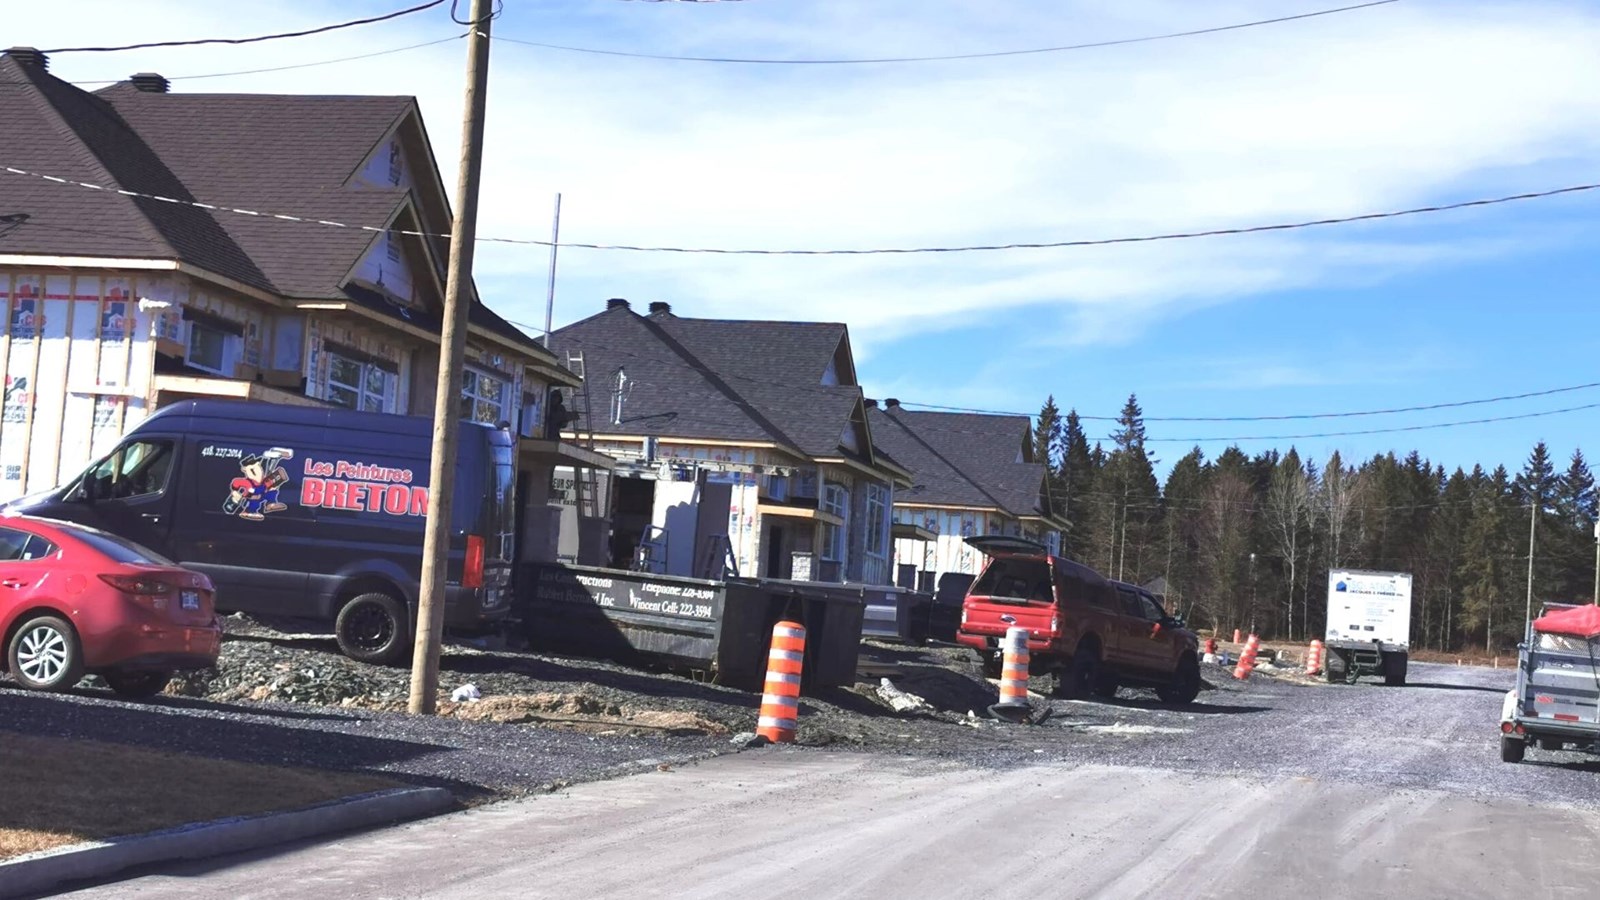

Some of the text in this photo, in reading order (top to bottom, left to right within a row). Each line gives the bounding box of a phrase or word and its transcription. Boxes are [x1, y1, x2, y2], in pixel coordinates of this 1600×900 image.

[304, 458, 412, 483] Les Peintures
[301, 478, 429, 516] BRETON
[633, 597, 712, 618] Vincent Cell: 222-3594
